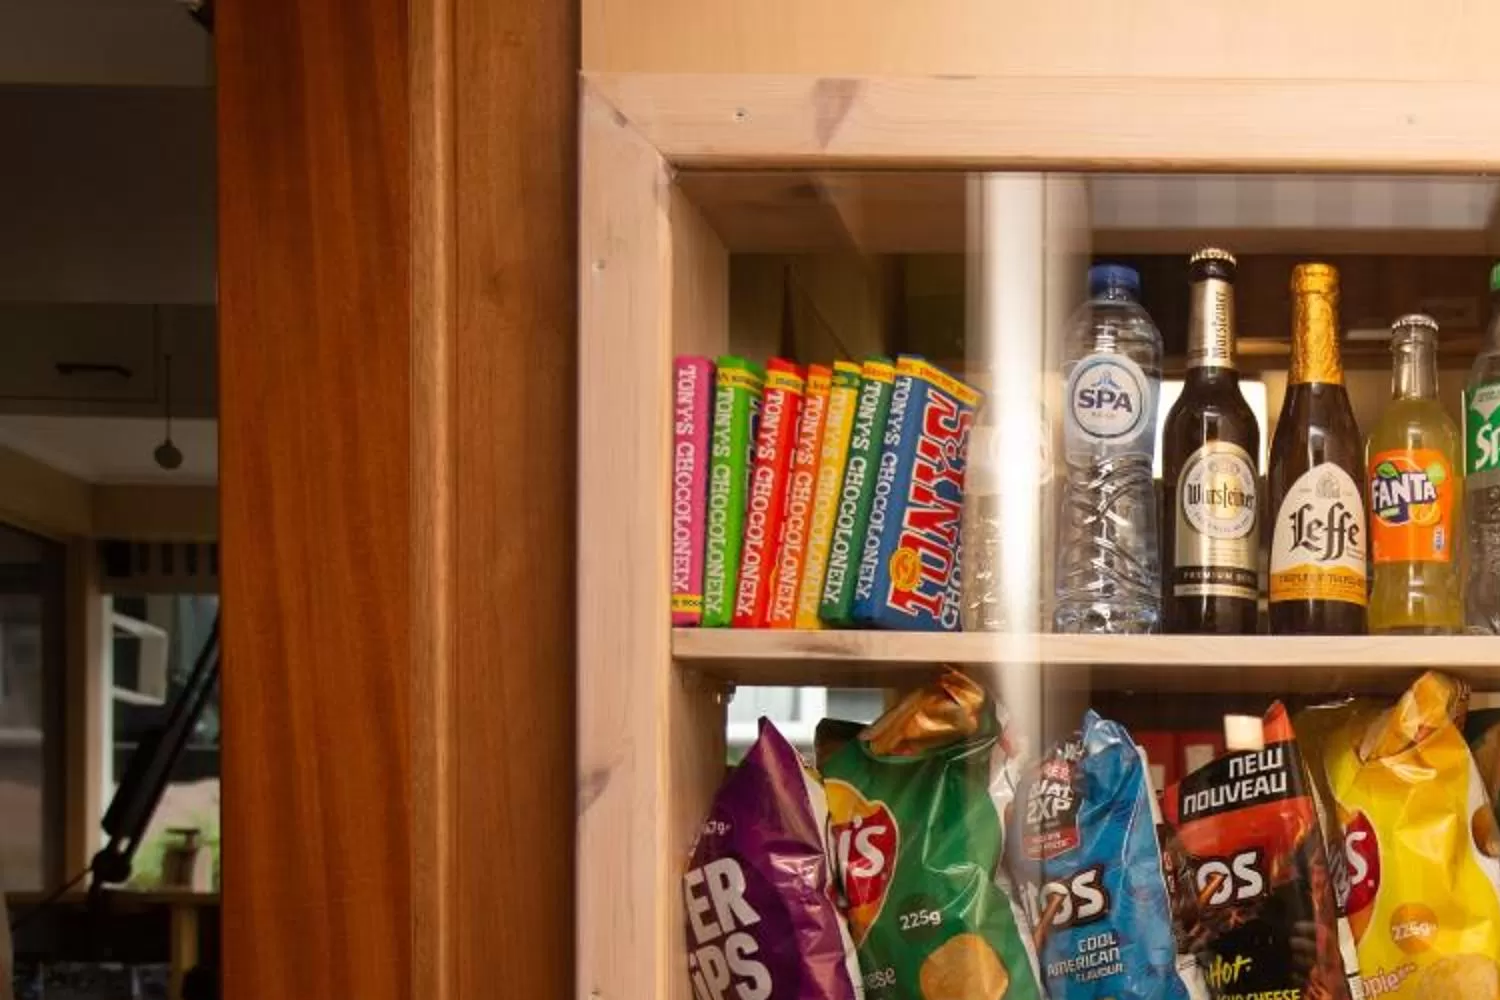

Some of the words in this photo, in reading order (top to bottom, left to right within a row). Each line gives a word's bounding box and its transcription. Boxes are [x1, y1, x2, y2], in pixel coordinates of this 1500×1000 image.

[1078, 387, 1133, 414] SPA
[1371, 472, 1436, 513] FANTA
[1288, 501, 1360, 562] Leffe
[1229, 747, 1284, 780] NEW
[1183, 772, 1288, 816] NOUVEAU
[900, 909, 942, 931] 225g
[1077, 931, 1117, 953] COOL
[1047, 947, 1121, 978] AMERICAN
